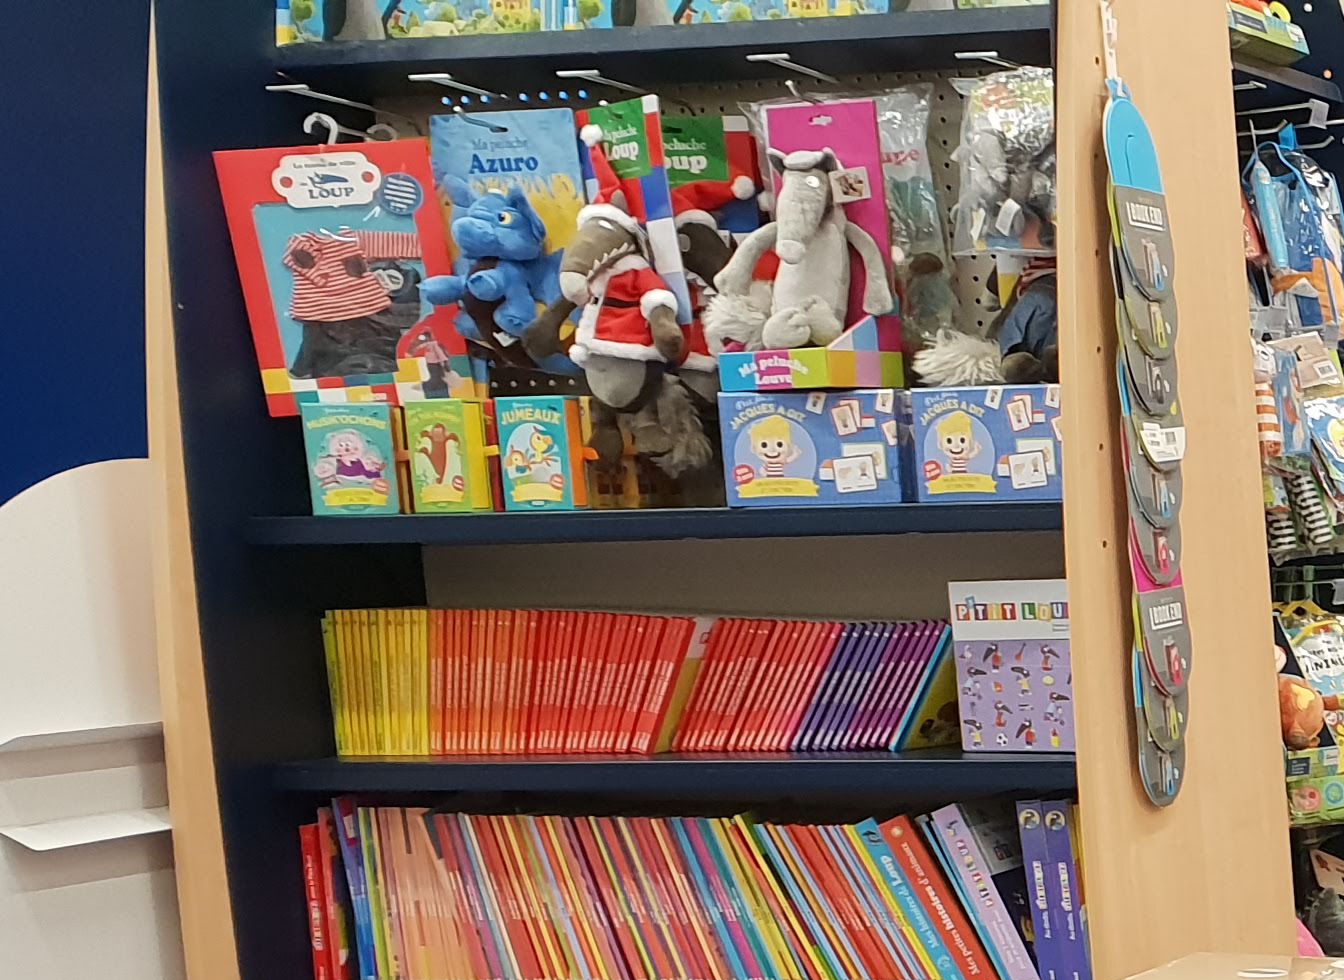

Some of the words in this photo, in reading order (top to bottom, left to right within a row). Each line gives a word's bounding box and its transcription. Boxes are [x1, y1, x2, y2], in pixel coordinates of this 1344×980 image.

[605, 142, 639, 161] Loup
[468, 154, 539, 174] Azuro
[662, 154, 707, 171] oup
[309, 186, 354, 199] LOUP
[501, 409, 560, 425] JUMEAUX
[1021, 602, 1068, 621] LOU
[880, 855, 903, 887] Loup
[925, 884, 956, 932] histoires
